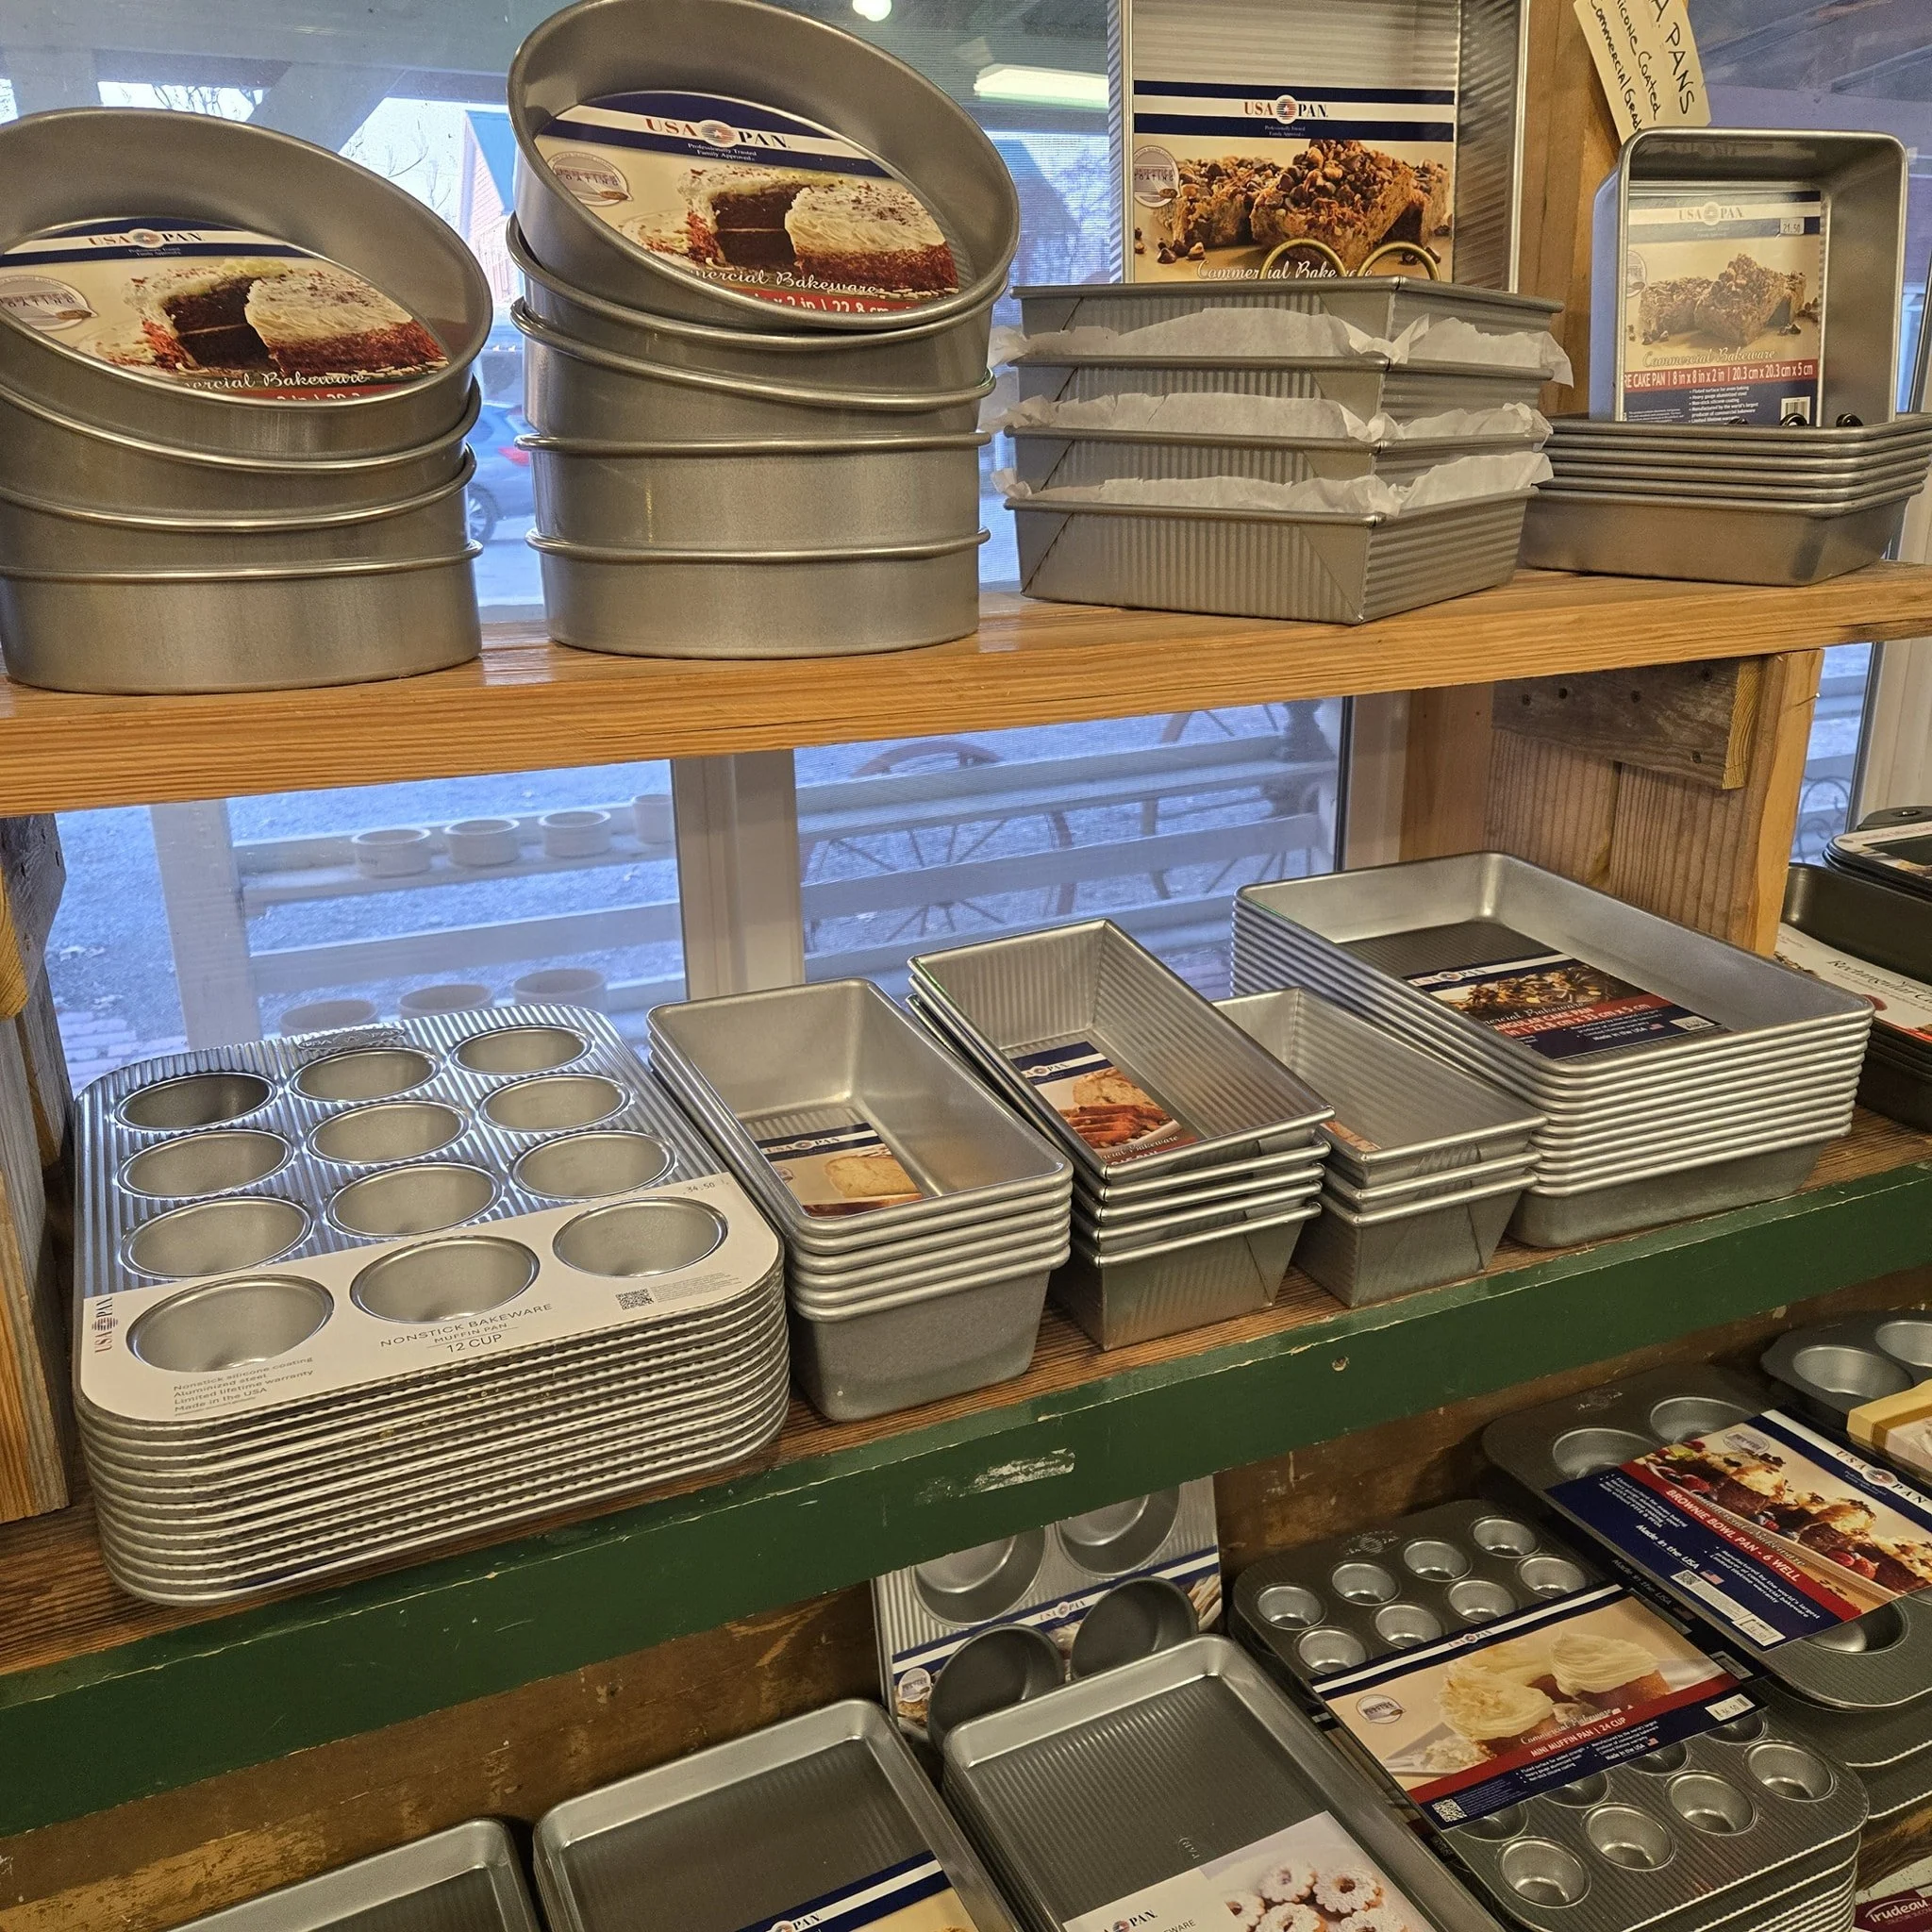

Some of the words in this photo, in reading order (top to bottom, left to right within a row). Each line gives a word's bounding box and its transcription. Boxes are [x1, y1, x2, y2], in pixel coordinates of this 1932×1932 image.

[1665, 23, 1694, 114] PANS
[1244, 102, 1274, 116] USA
[1298, 104, 1328, 117] PAN
[645, 118, 698, 138] USA
[738, 130, 791, 149] PAN
[688, 142, 731, 153] Professionally
[732, 148, 758, 157] Trusted
[1678, 209, 1702, 221] USA
[1720, 208, 1743, 219] PAN
[88, 235, 131, 246] USA
[161, 232, 204, 242] PAN
[1783, 224, 1801, 234] 21.50
[691, 268, 769, 284] mercial
[775, 271, 878, 294] Bakeware
[1197, 259, 1291, 279] Commerial
[1642, 348, 1713, 368] Commercial
[1717, 347, 1774, 363] Bakeware
[186, 374, 257, 390] ercial
[261, 371, 369, 388] Bakeware
[1633, 373, 1651, 388] CAKE
[1652, 372, 1666, 387] PAN
[1673, 371, 1677, 386] 8
[1679, 371, 1686, 385] in
[1691, 369, 1697, 383] 8
[1698, 369, 1705, 383] in
[1711, 369, 1717, 383] 2
[1718, 369, 1724, 382] in
[1732, 366, 1747, 380] 20.3
[1748, 369, 1758, 379] cm
[1765, 364, 1780, 378] 20.3
[1781, 366, 1790, 376] cm
[1798, 362, 1802, 375] 5
[1803, 364, 1813, 375] cm
[1493, 1018, 1543, 1031] ANGULAR
[1542, 1010, 1573, 1023] CAKE
[1573, 1007, 1594, 1016] PAN
[1557, 1018, 1575, 1026] cm
[95, 1296, 113, 1318] PAN
[380, 1324, 464, 1347] NONSTICK
[468, 1304, 553, 1329] BAKEWARE
[434, 1328, 480, 1344] MUFFIN
[484, 1323, 508, 1333] PAN
[94, 1330, 113, 1353] USA
[446, 1341, 466, 1353] 12
[468, 1334, 503, 1348] CUP
[174, 1376, 224, 1391] Nonstick
[226, 1366, 270, 1379] silicone
[272, 1357, 313, 1370] coating
[174, 1380, 236, 1397] Aluminized
[239, 1374, 267, 1384] steel
[174, 1391, 217, 1405] Limited
[219, 1380, 262, 1395] lifetime
[265, 1370, 314, 1385] warranty
[175, 1401, 206, 1412] Made
[223, 1393, 241, 1402] the
[243, 1387, 267, 1397] USA
[1836, 1450, 1867, 1470] USA
[1891, 1483, 1927, 1504] PAN
[1636, 1524, 1658, 1541] Made
[1657, 1539, 1668, 1547] in
[1666, 1545, 1682, 1557] the
[1681, 1556, 1700, 1570] USA
[1665, 1490, 1710, 1520] BROWNIE
[1707, 1517, 1736, 1539] BOWL
[1735, 1536, 1758, 1554] PAN
[1772, 1558, 1802, 1582] WELL
[1709, 1554, 1732, 1570] Limited
[1730, 1567, 1754, 1584] lifetime
[1753, 1583, 1778, 1604] warranty
[1716, 1552, 1741, 1569] producer
[1748, 1573, 1781, 1598] commercial
[1779, 1596, 1809, 1618] bakeware
[1722, 1550, 1761, 1576] Manufactured
[1758, 1573, 1767, 1582] by
[1766, 1579, 1778, 1590] the
[1777, 1589, 1799, 1605] world's
[1798, 1603, 1821, 1619] largest
[1641, 1580, 1657, 1594] the
[1655, 1591, 1673, 1606] USA
[1530, 1745, 1548, 1757] MINI
[1548, 1735, 1579, 1751] MUFFIN
[1577, 1729, 1594, 1740] PAN
[1598, 1723, 1611, 1732] 24
[1610, 1717, 1627, 1728] CUP
[1605, 1752, 1621, 1760] Made
[1634, 1742, 1647, 1751] USA
[792, 1912, 822, 1930] PAN
[1128, 1909, 1158, 1926] PAN
[1870, 1899, 1929, 1923] Trudeau
